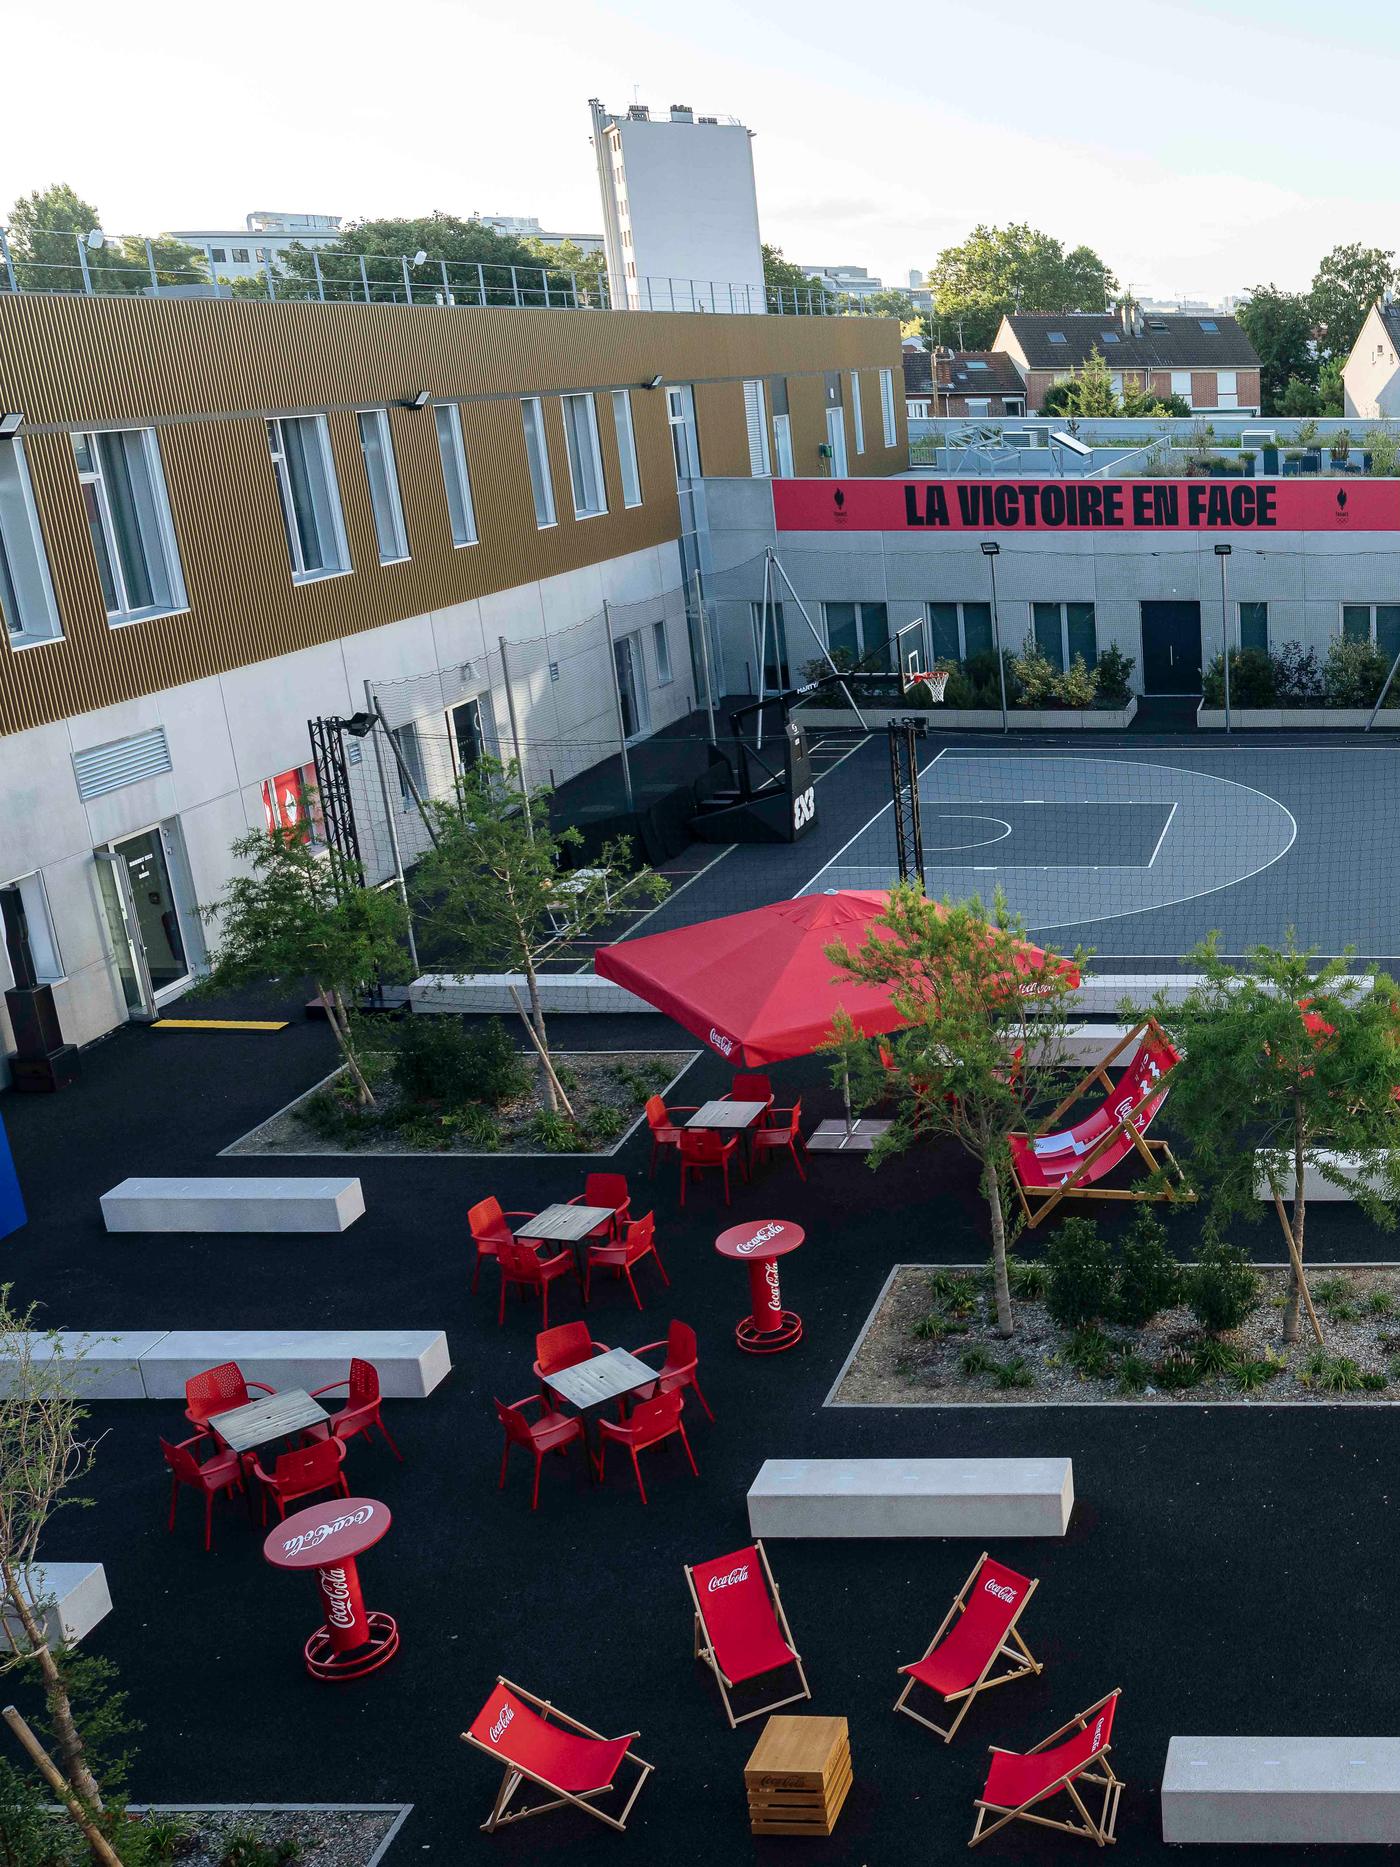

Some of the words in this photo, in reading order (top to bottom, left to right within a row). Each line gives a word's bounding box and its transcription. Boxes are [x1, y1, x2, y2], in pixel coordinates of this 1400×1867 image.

[904, 485, 950, 526] LA
[957, 485, 1124, 527] VICTOIRE
[1132, 485, 1179, 526] EN
[1187, 485, 1277, 527] FACE
[736, 1222, 785, 1254] Coca-Cola
[282, 1505, 374, 1559] Coca-Cola
[320, 1567, 356, 1629] Coca-Cola
[708, 1564, 749, 1592] Coca-Cola
[984, 1578, 1018, 1604] Coca-Cola
[489, 1701, 515, 1743] Coca-Cola
